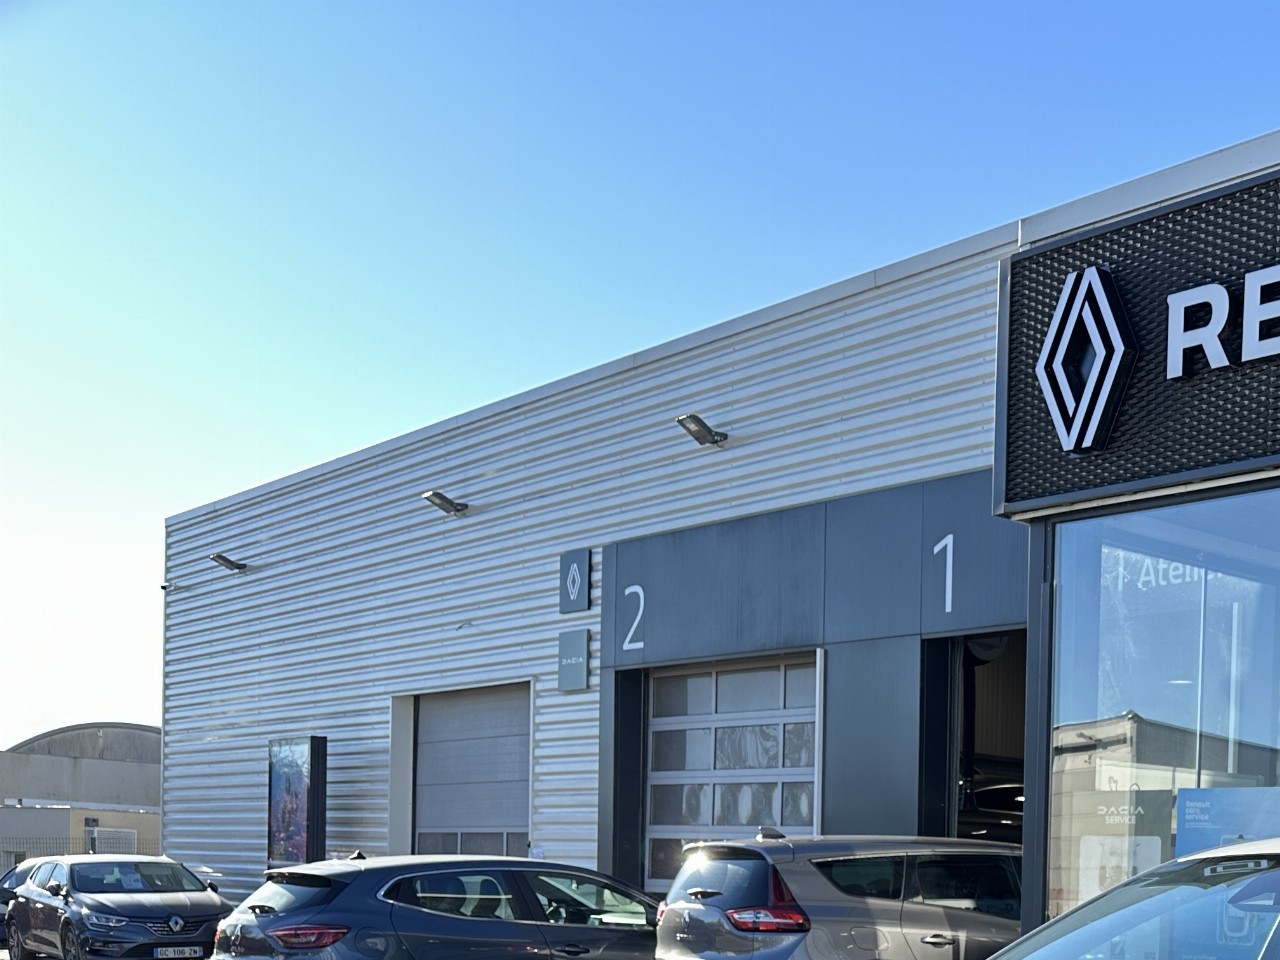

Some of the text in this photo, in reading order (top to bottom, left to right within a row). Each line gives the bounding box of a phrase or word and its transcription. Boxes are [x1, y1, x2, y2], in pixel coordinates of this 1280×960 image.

[933, 533, 953, 612] 1
[622, 585, 645, 650] 2
[561, 656, 583, 665] DACIA
[1097, 805, 1145, 815] DACIA
[1105, 815, 1137, 825] SERVICE
